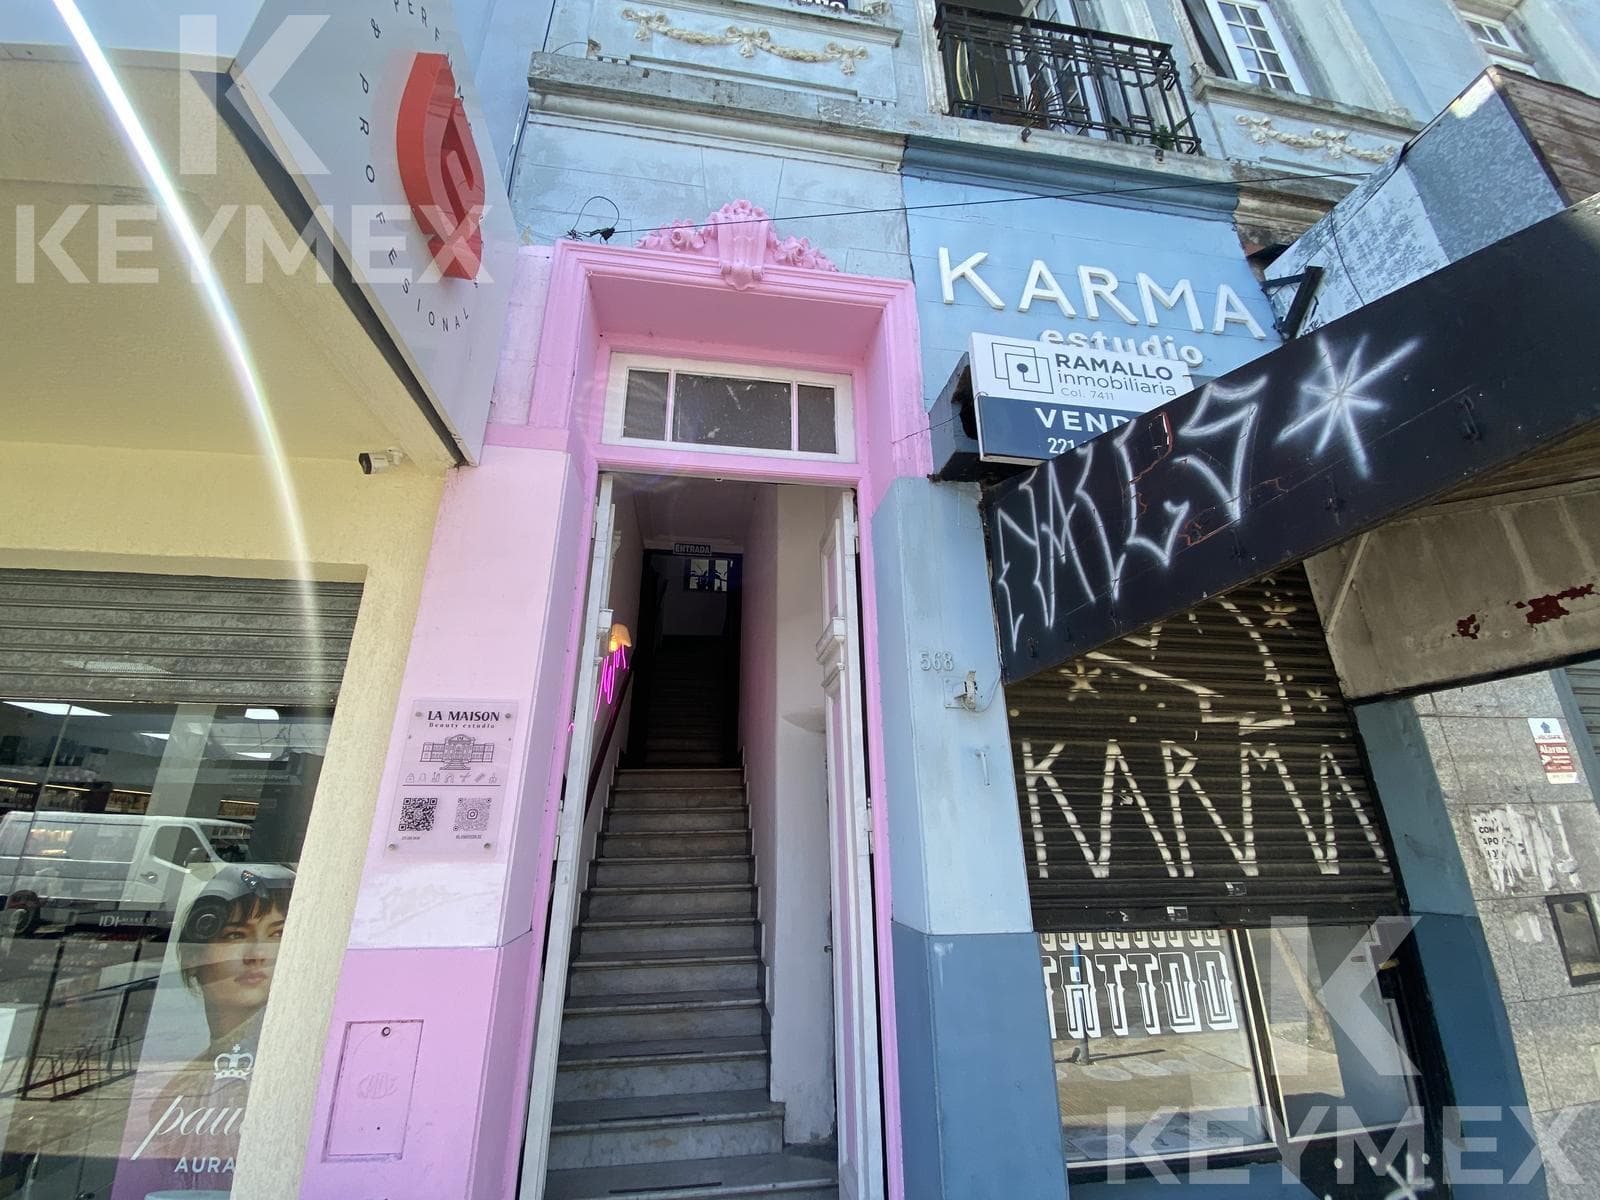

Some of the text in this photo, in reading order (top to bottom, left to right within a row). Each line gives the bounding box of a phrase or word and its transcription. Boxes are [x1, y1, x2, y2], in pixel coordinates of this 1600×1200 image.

[359, 72, 470, 333] PROFESIONAL
[938, 247, 1267, 340] KARMA
[1040, 329, 1203, 367] estudio
[1055, 353, 1173, 380] RAMALLO
[1058, 370, 1177, 396] inmobiliaria
[1061, 388, 1114, 400] Col. 7411
[1047, 437, 1075, 454] 221
[675, 545, 710, 554] ENTRADA
[428, 711, 500, 721] LA MAISON
[1021, 738, 1391, 878] KARMA
[174, 1157, 236, 1173] AURA
